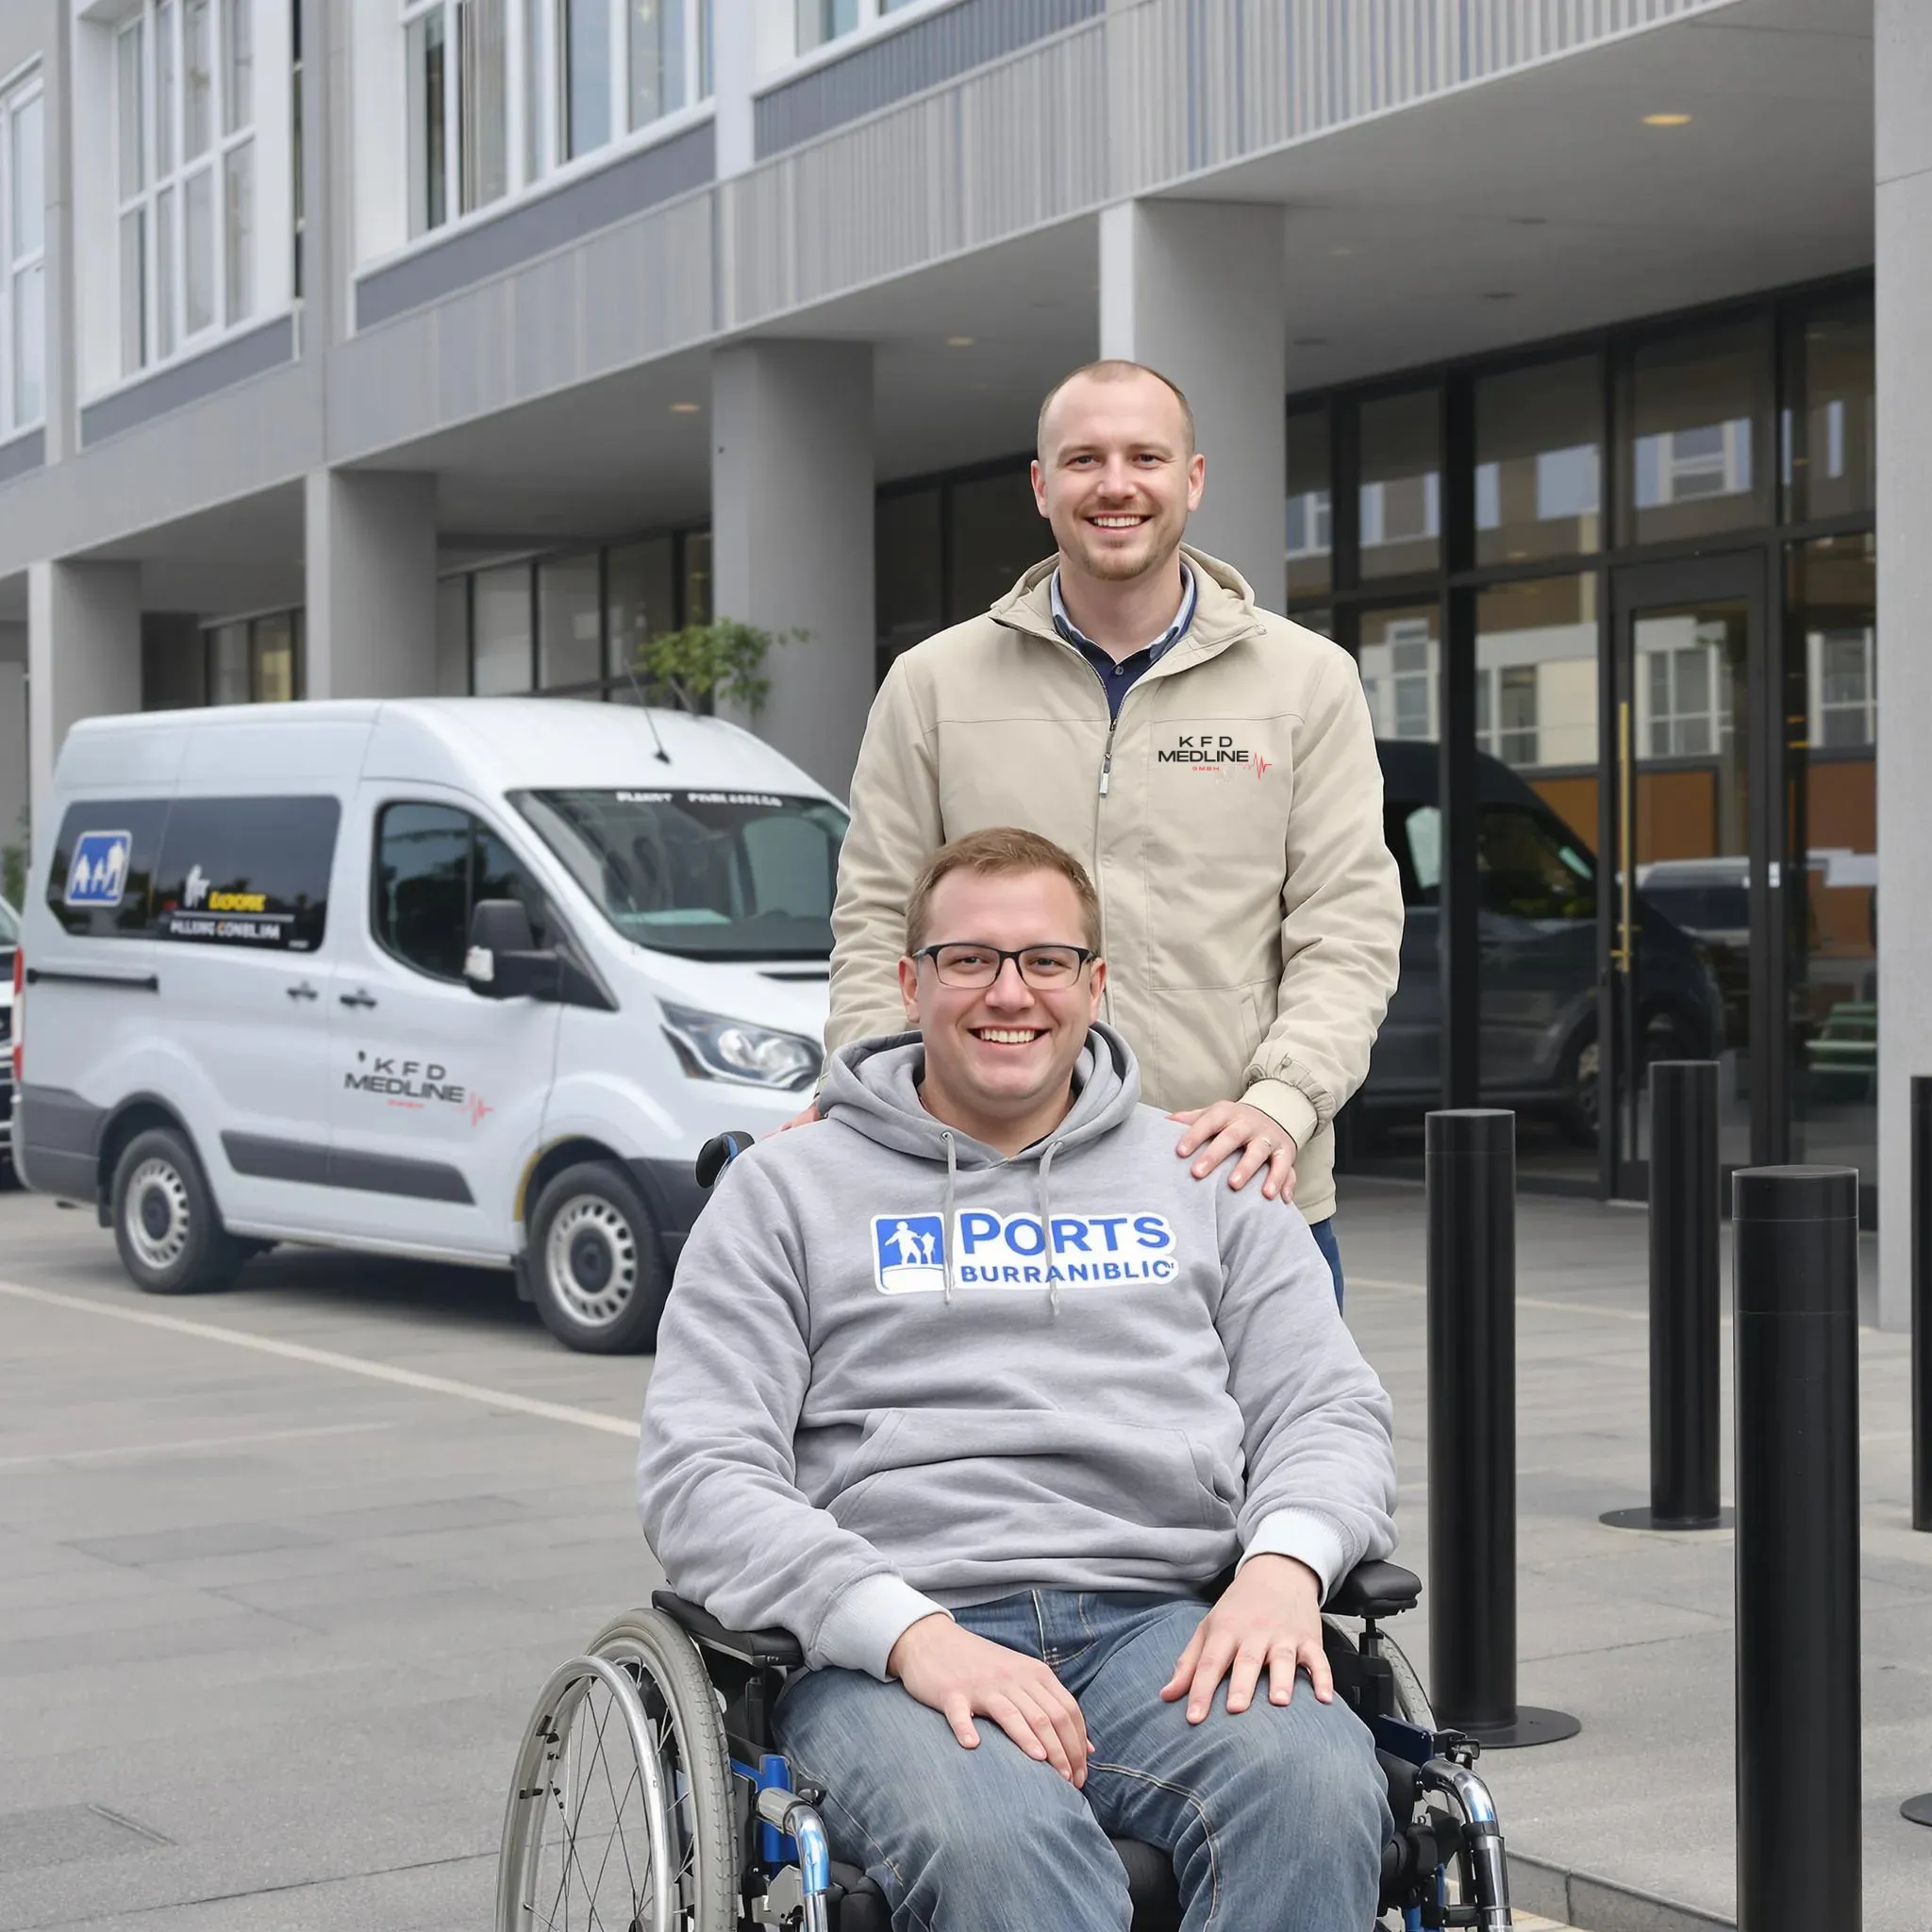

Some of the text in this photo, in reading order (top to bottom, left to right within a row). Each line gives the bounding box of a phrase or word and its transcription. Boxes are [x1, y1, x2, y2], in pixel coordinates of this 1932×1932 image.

[1158, 750, 1249, 762] MEDLINE
[344, 1073, 465, 1103] MEDLINE
[960, 1212, 1171, 1256] PORTS
